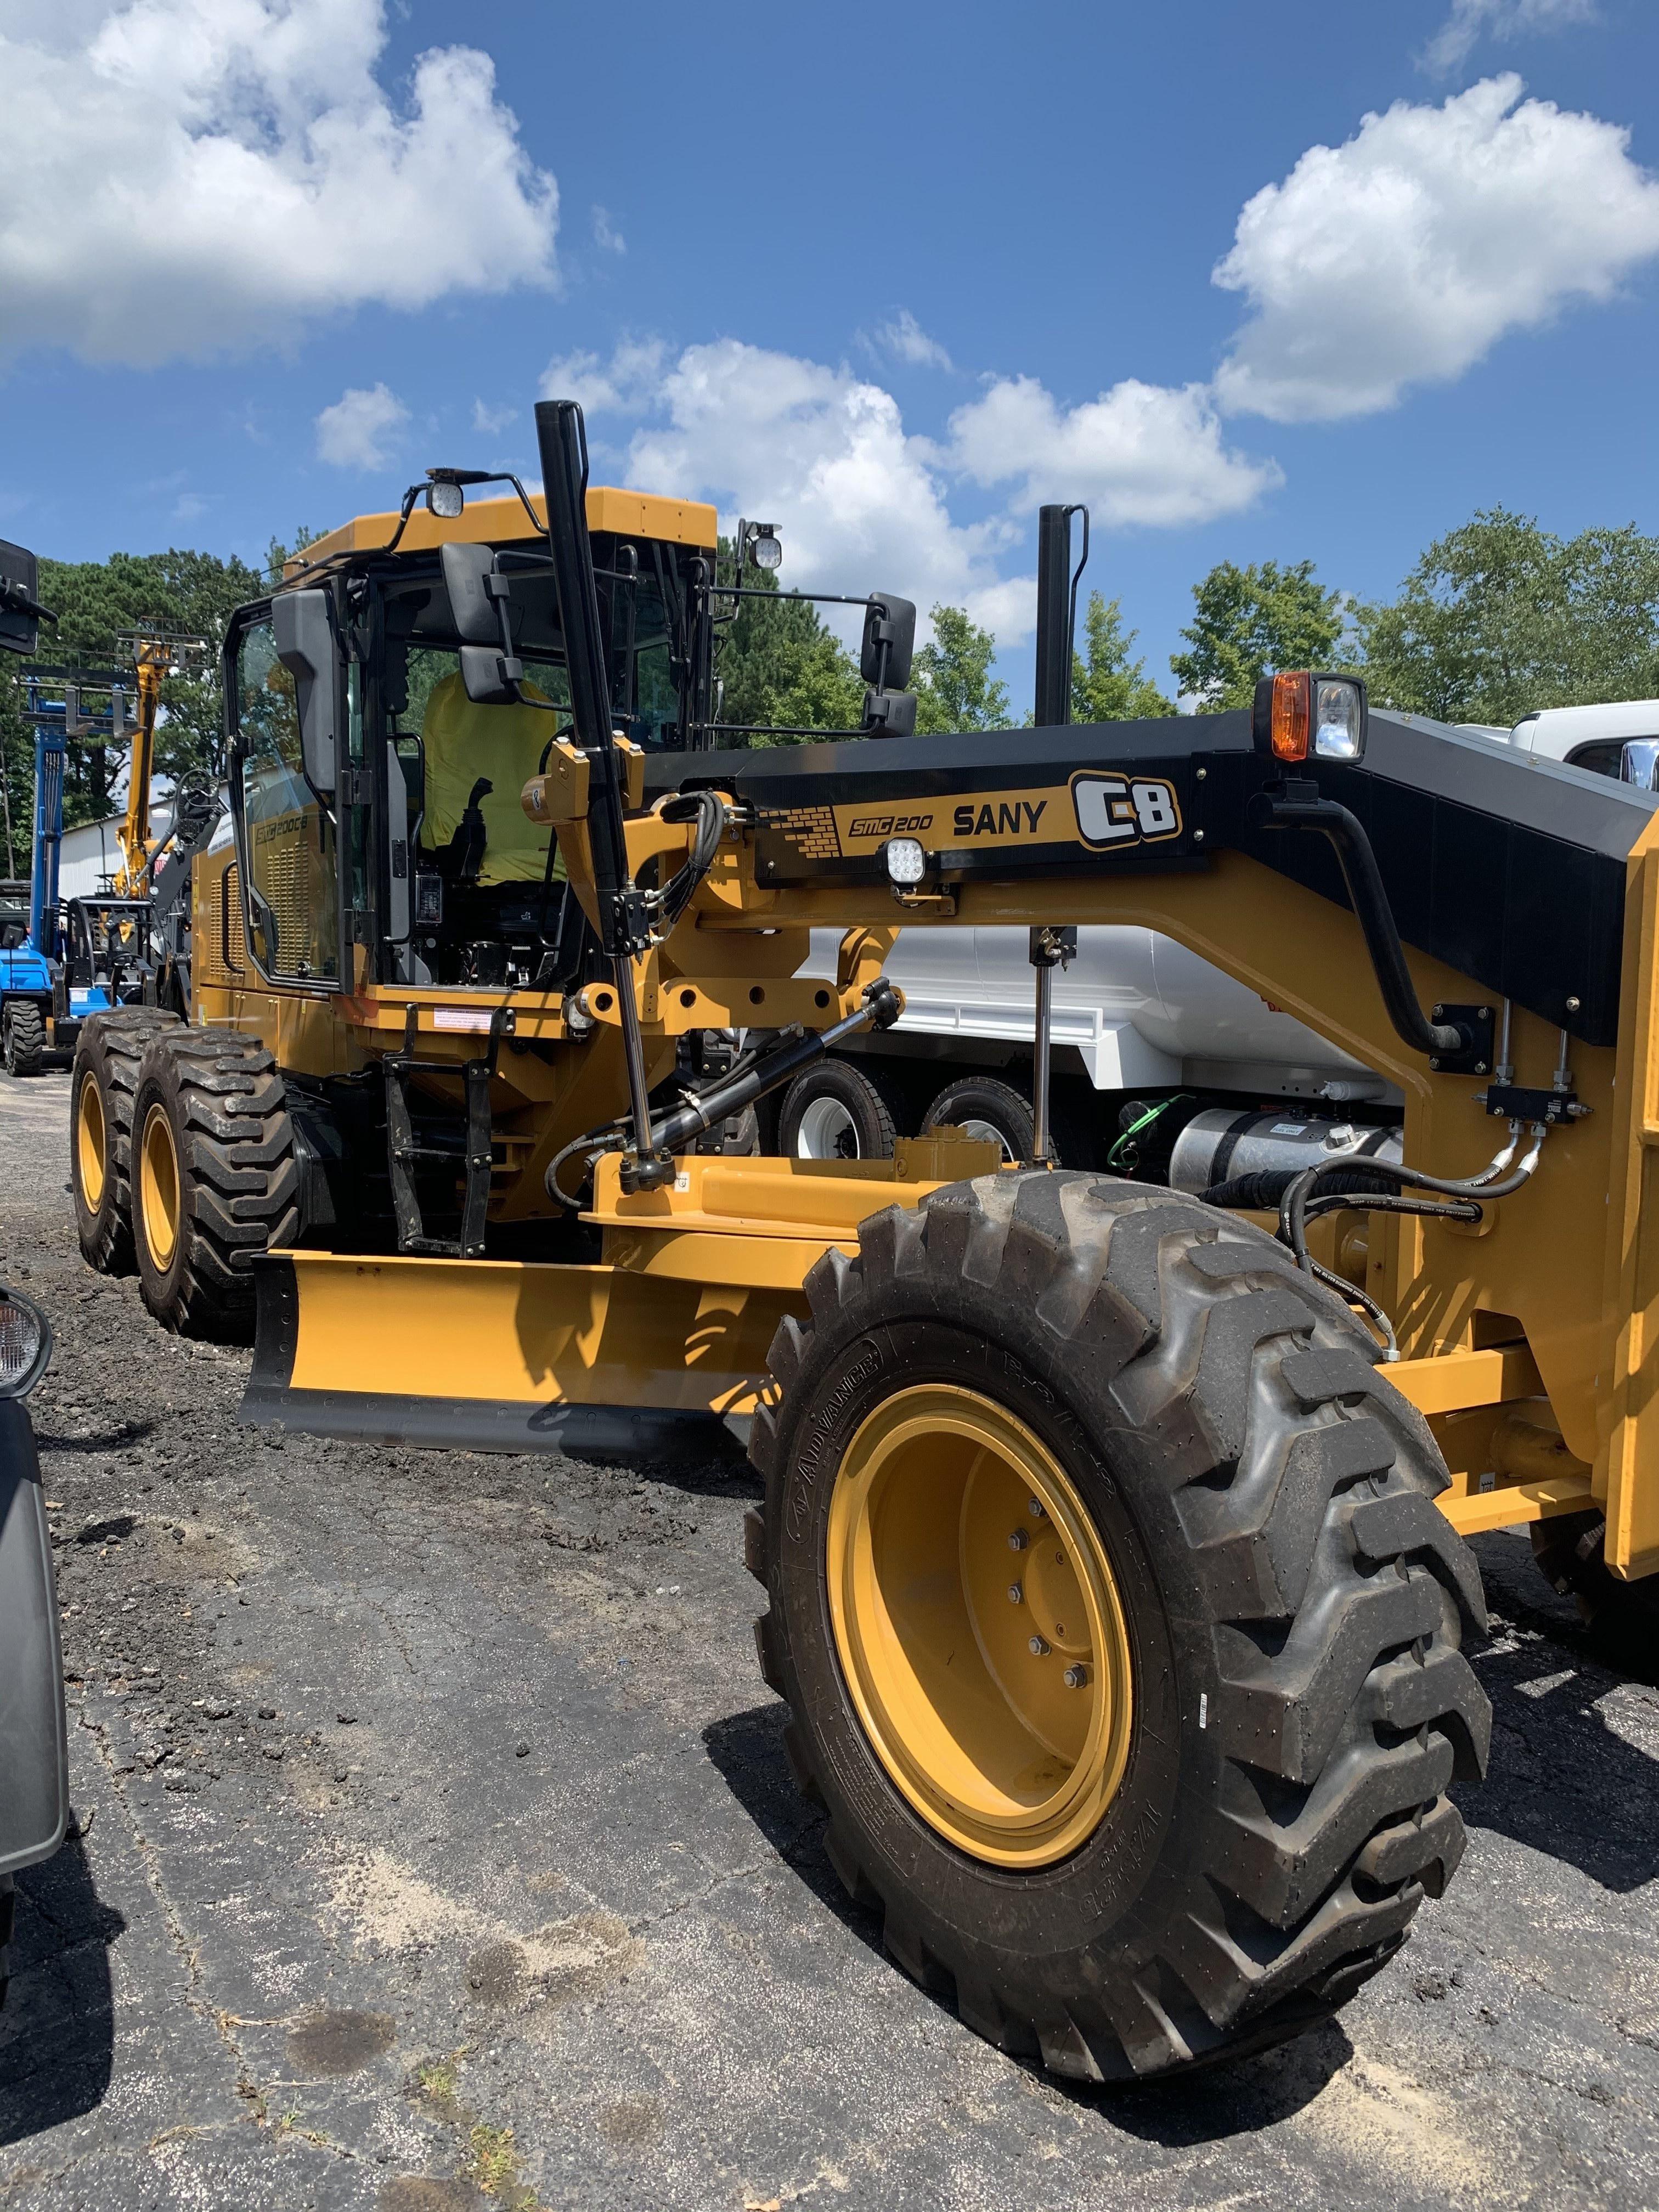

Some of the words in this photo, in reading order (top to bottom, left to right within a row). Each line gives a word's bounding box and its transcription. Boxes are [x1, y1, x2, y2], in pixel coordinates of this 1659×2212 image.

[953, 800, 1048, 836] SANY
[1321, 1272, 1336, 1283] SILVER
[1335, 1280, 1353, 1293] DIAMOND
[797, 1352, 879, 1486] ADVANCE
